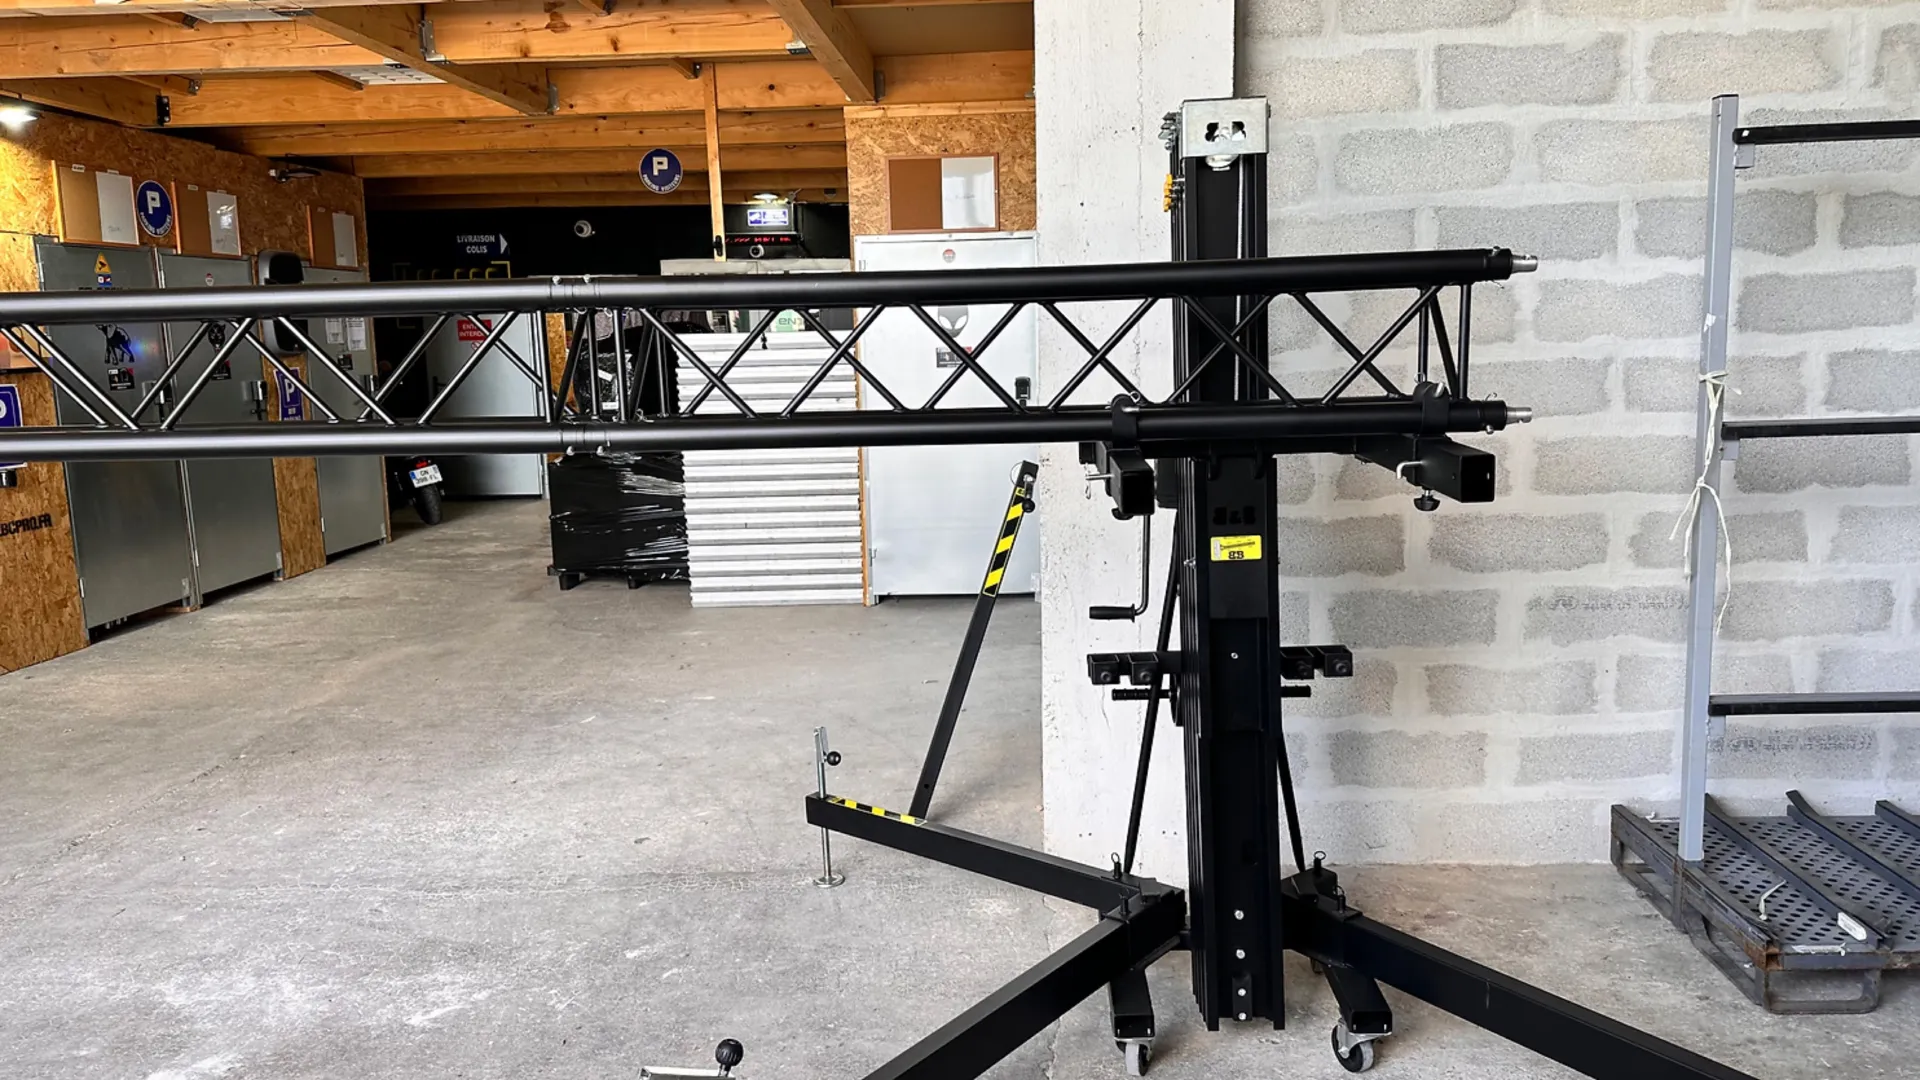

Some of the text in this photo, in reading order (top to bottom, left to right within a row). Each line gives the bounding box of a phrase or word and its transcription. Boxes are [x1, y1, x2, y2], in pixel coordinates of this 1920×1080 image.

[653, 156, 668, 176] P
[146, 190, 161, 214] P
[456, 234, 496, 243] LIVRAISON
[466, 245, 488, 253] COLIS
[284, 378, 295, 402] P
[0, 512, 53, 537] BCPRO.FR
